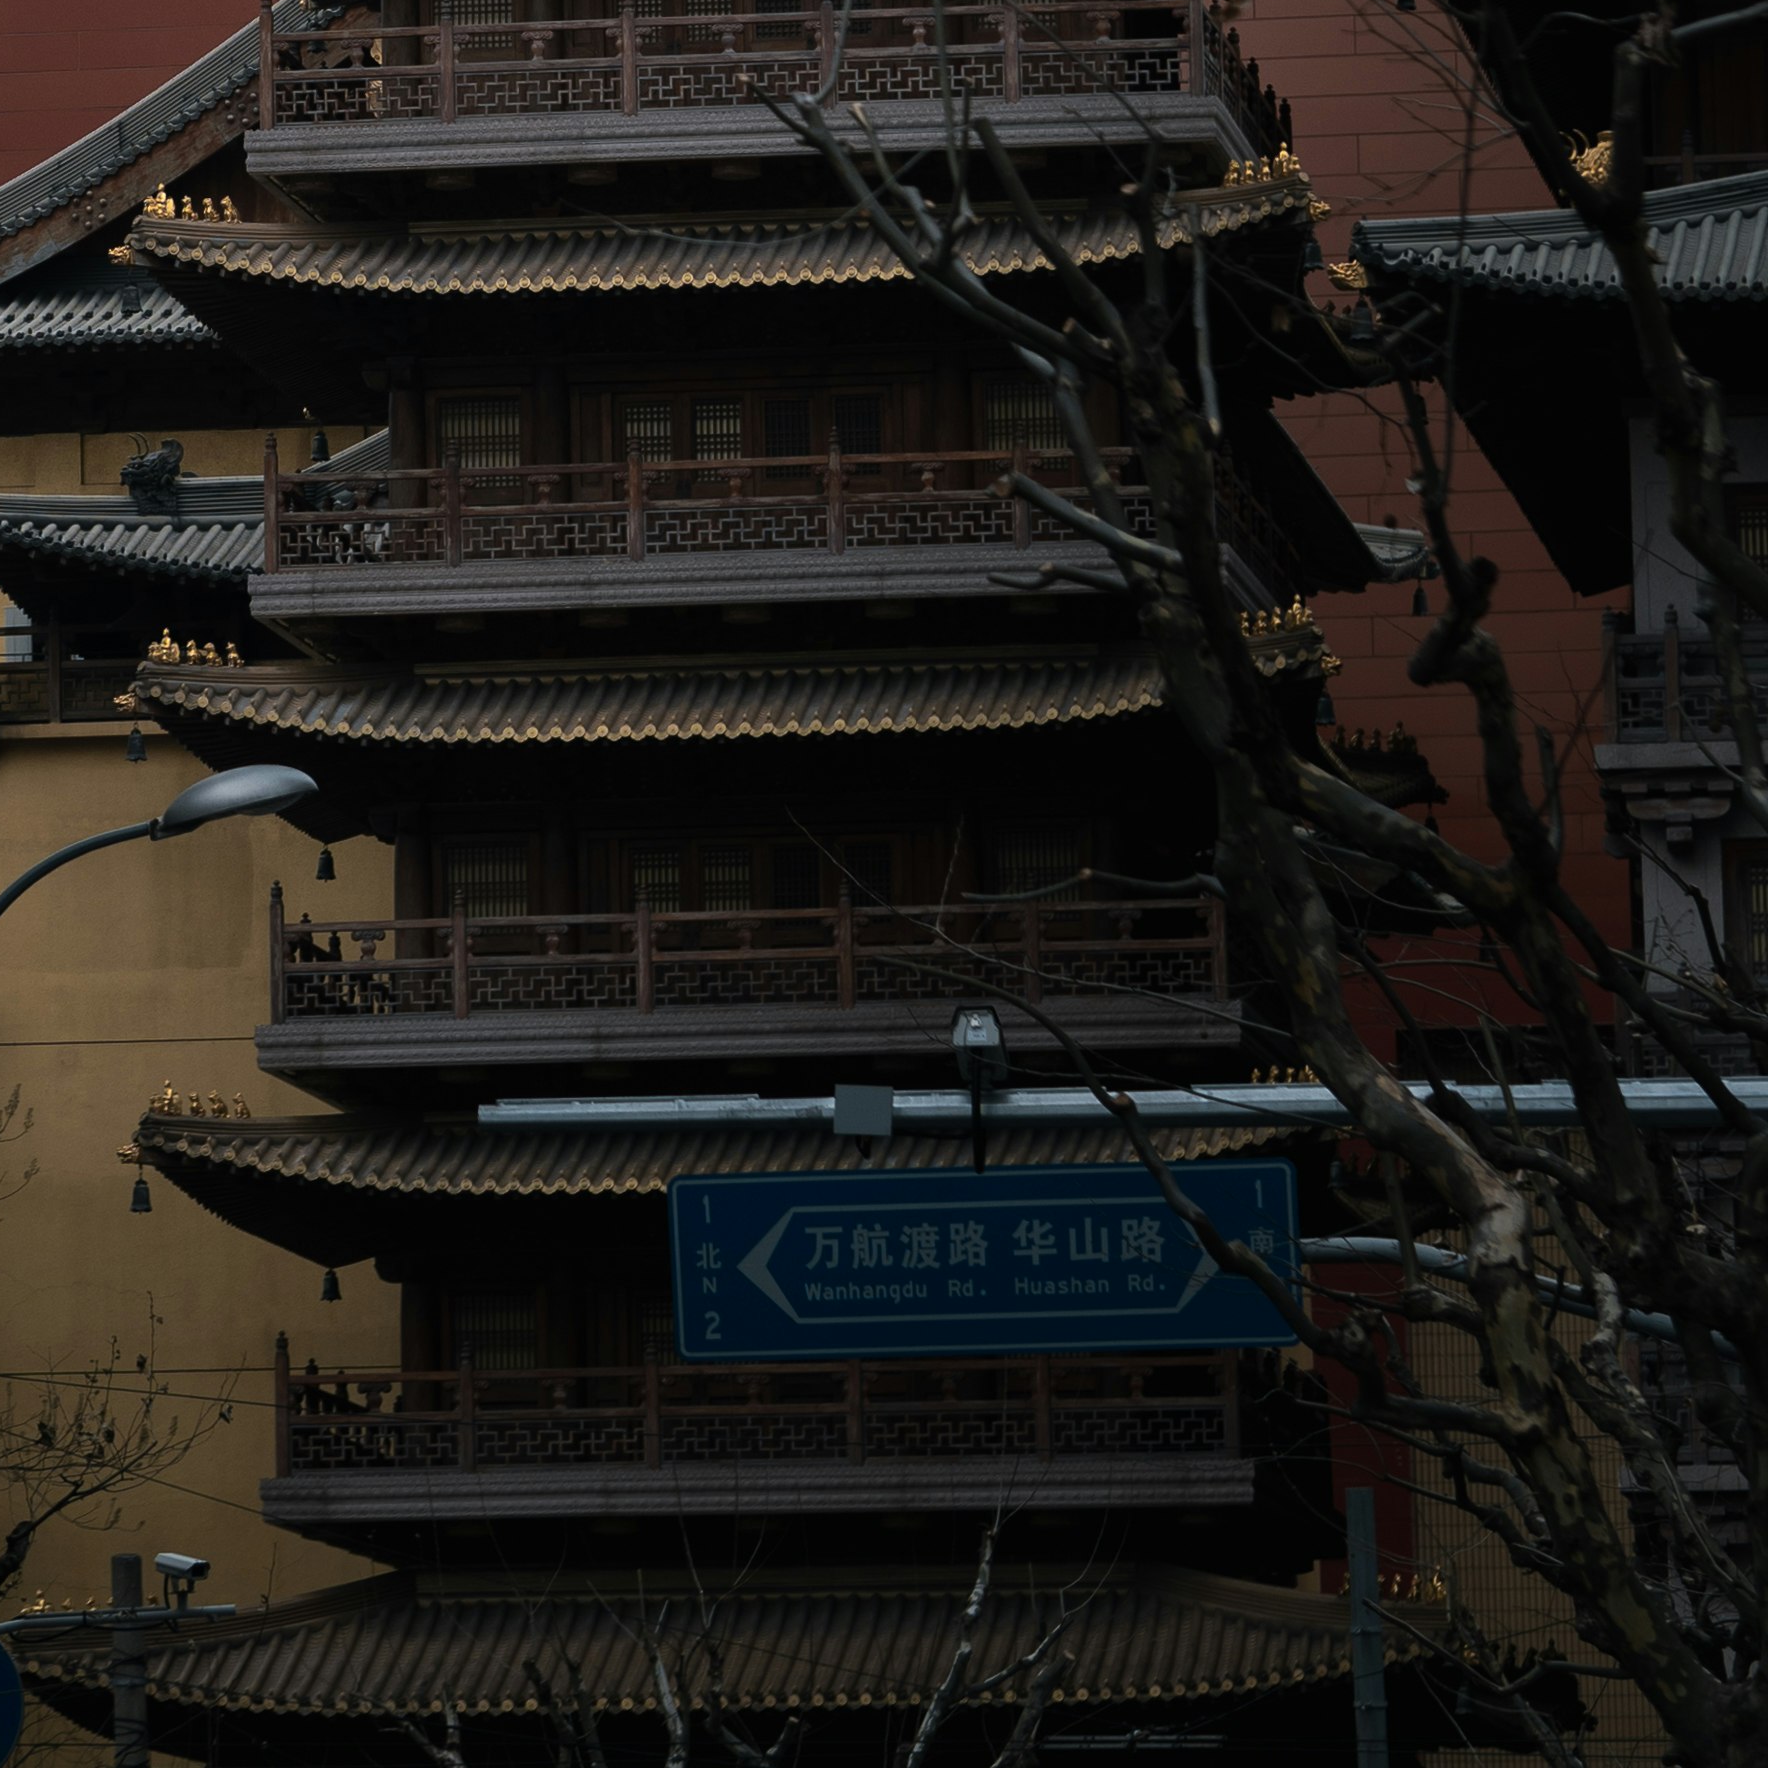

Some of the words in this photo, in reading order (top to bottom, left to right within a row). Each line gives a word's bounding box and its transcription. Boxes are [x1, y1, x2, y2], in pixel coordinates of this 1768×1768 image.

[701, 1193, 712, 1224] 1
[1254, 1178, 1264, 1209] 1
[695, 1241, 723, 1271] 北
[803, 1219, 990, 1271] 万航渡路
[1011, 1216, 1167, 1266] 华山路
[1247, 1226, 1275, 1257] 南
[702, 1276, 718, 1295] N
[804, 1280, 929, 1305] Wanhangdu
[947, 1278, 988, 1298] Rd.
[1013, 1275, 1111, 1296] Huashan
[1127, 1273, 1167, 1293] Rd.
[704, 1310, 723, 1342] 2
